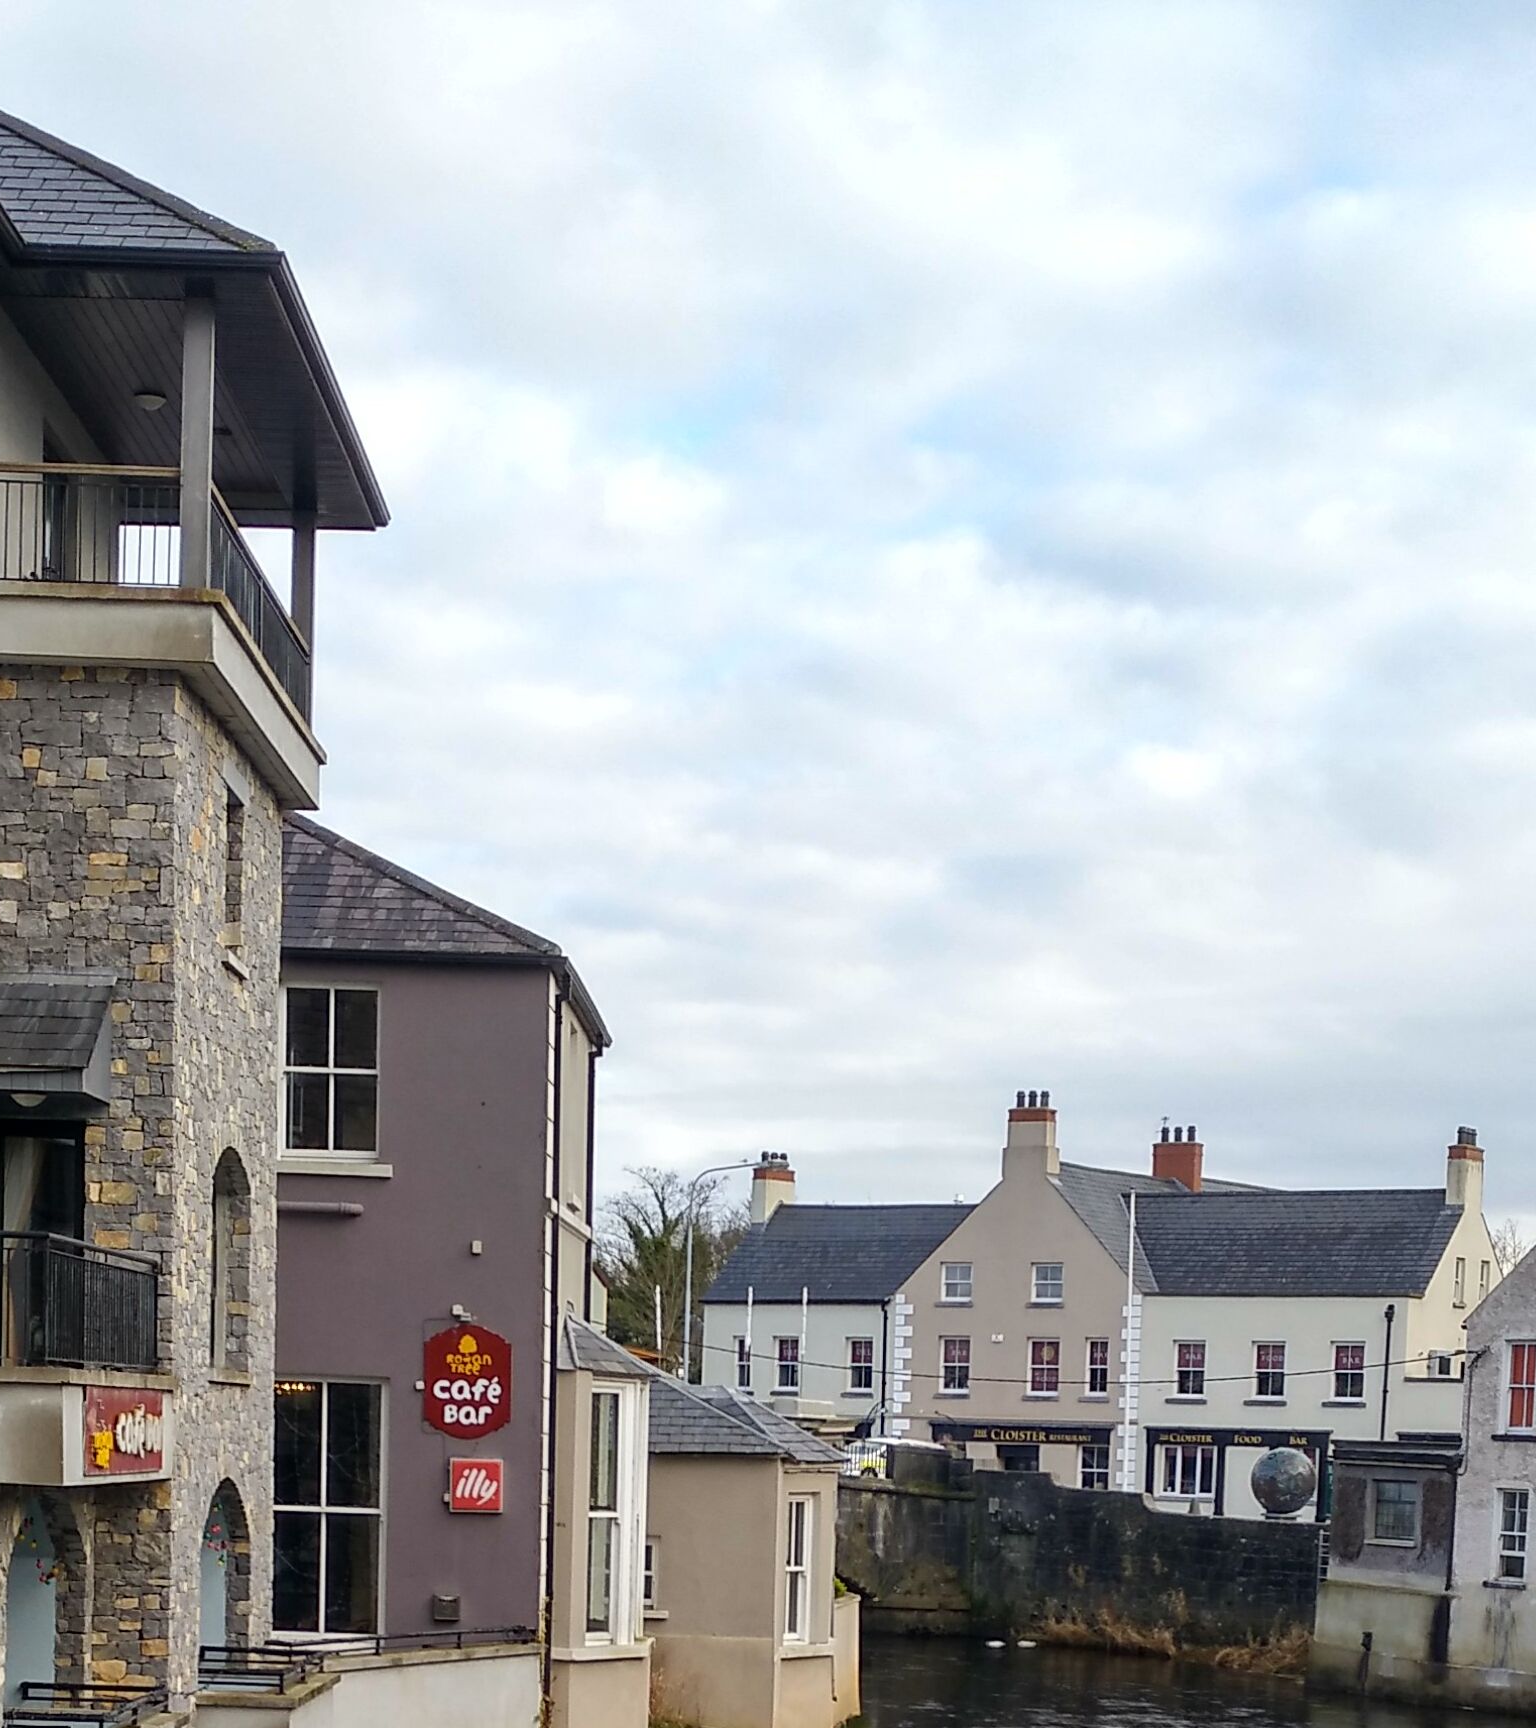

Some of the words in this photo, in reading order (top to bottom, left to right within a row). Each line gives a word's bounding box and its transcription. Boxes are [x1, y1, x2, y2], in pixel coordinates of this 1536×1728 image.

[1342, 1356, 1361, 1364] BAR
[433, 1376, 502, 1404] café
[990, 1428, 1047, 1442] CLOISTER
[1234, 1434, 1262, 1444] FOOD
[1289, 1435, 1308, 1445] BAR
[455, 1468, 498, 1505] illy
